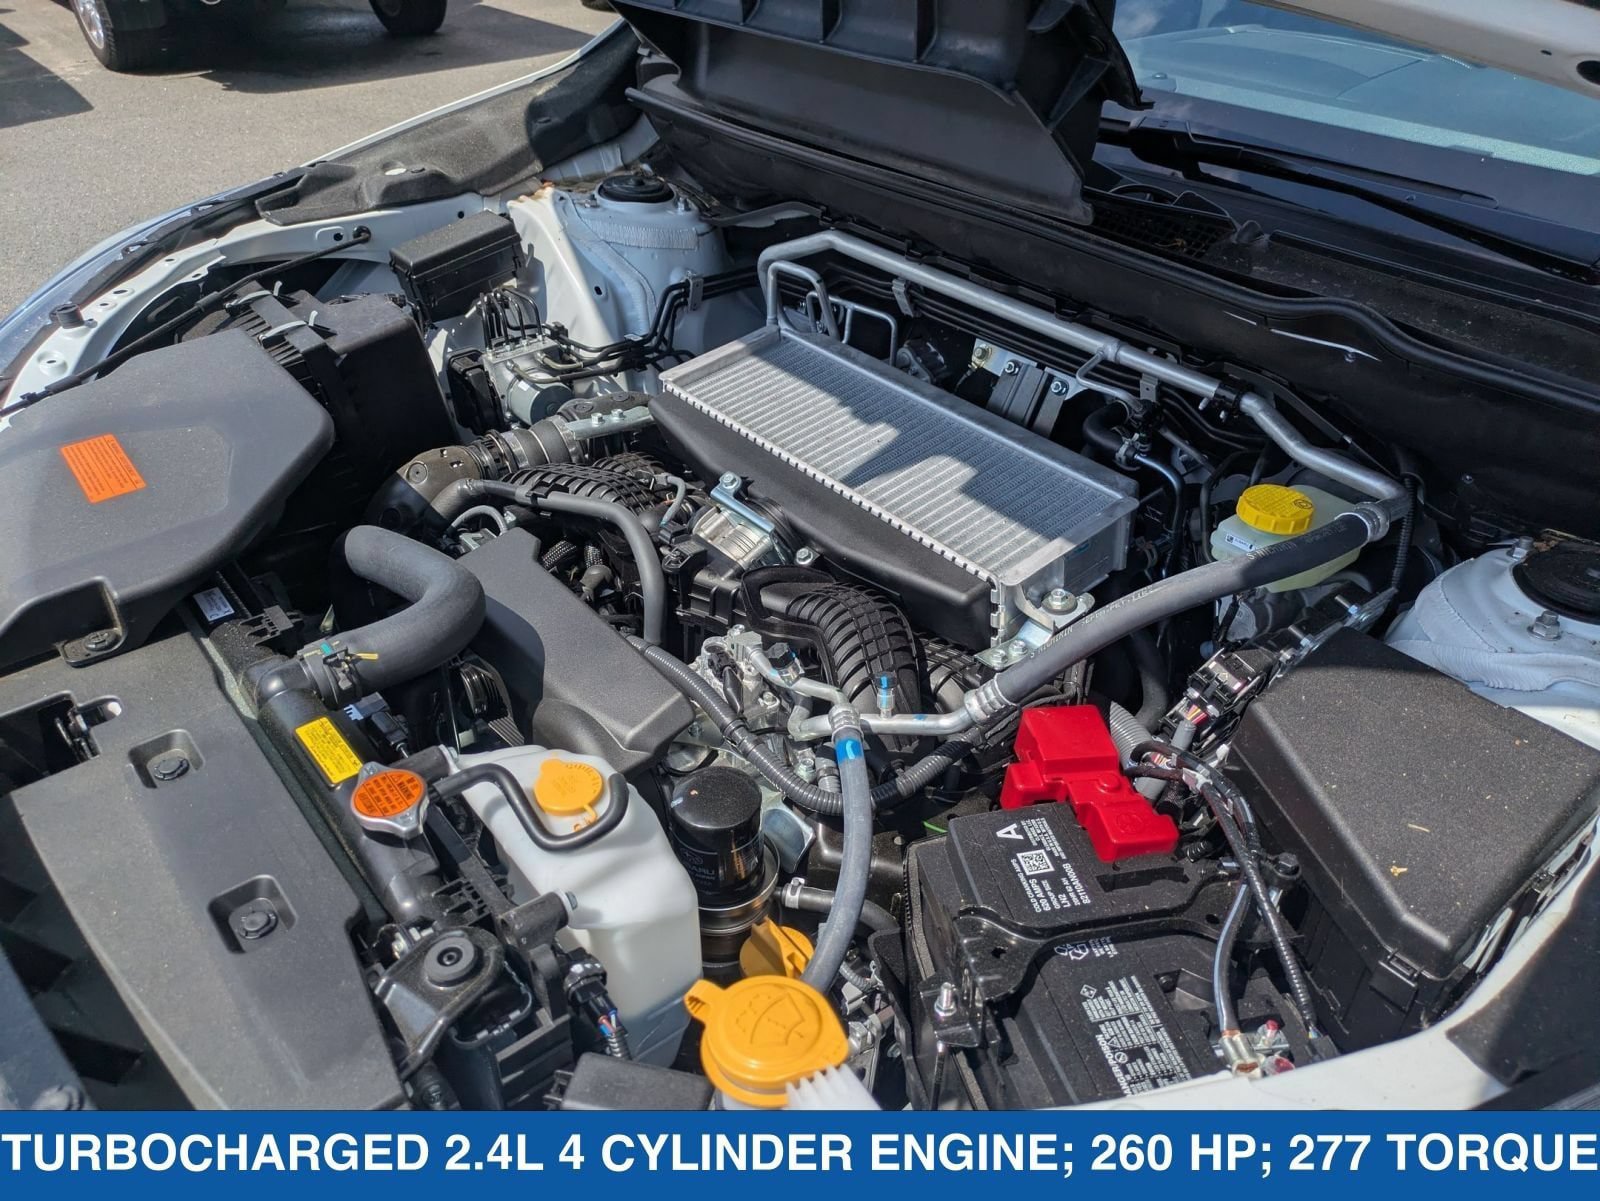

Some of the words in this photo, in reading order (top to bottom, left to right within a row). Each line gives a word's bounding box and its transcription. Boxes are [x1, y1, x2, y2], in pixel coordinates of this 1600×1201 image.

[996, 824, 1023, 839] A
[1011, 859, 1021, 872] AMPS
[1018, 873, 1034, 898] CRANKING
[1029, 879, 1044, 897] AMPS
[1042, 880, 1051, 890] SIZE
[1063, 864, 1090, 903] 82110AN00B
[1031, 898, 1041, 912] COLD
[1040, 899, 1050, 910] 620
[1048, 892, 1060, 909] GROUP
[1058, 894, 1070, 907] LN2
